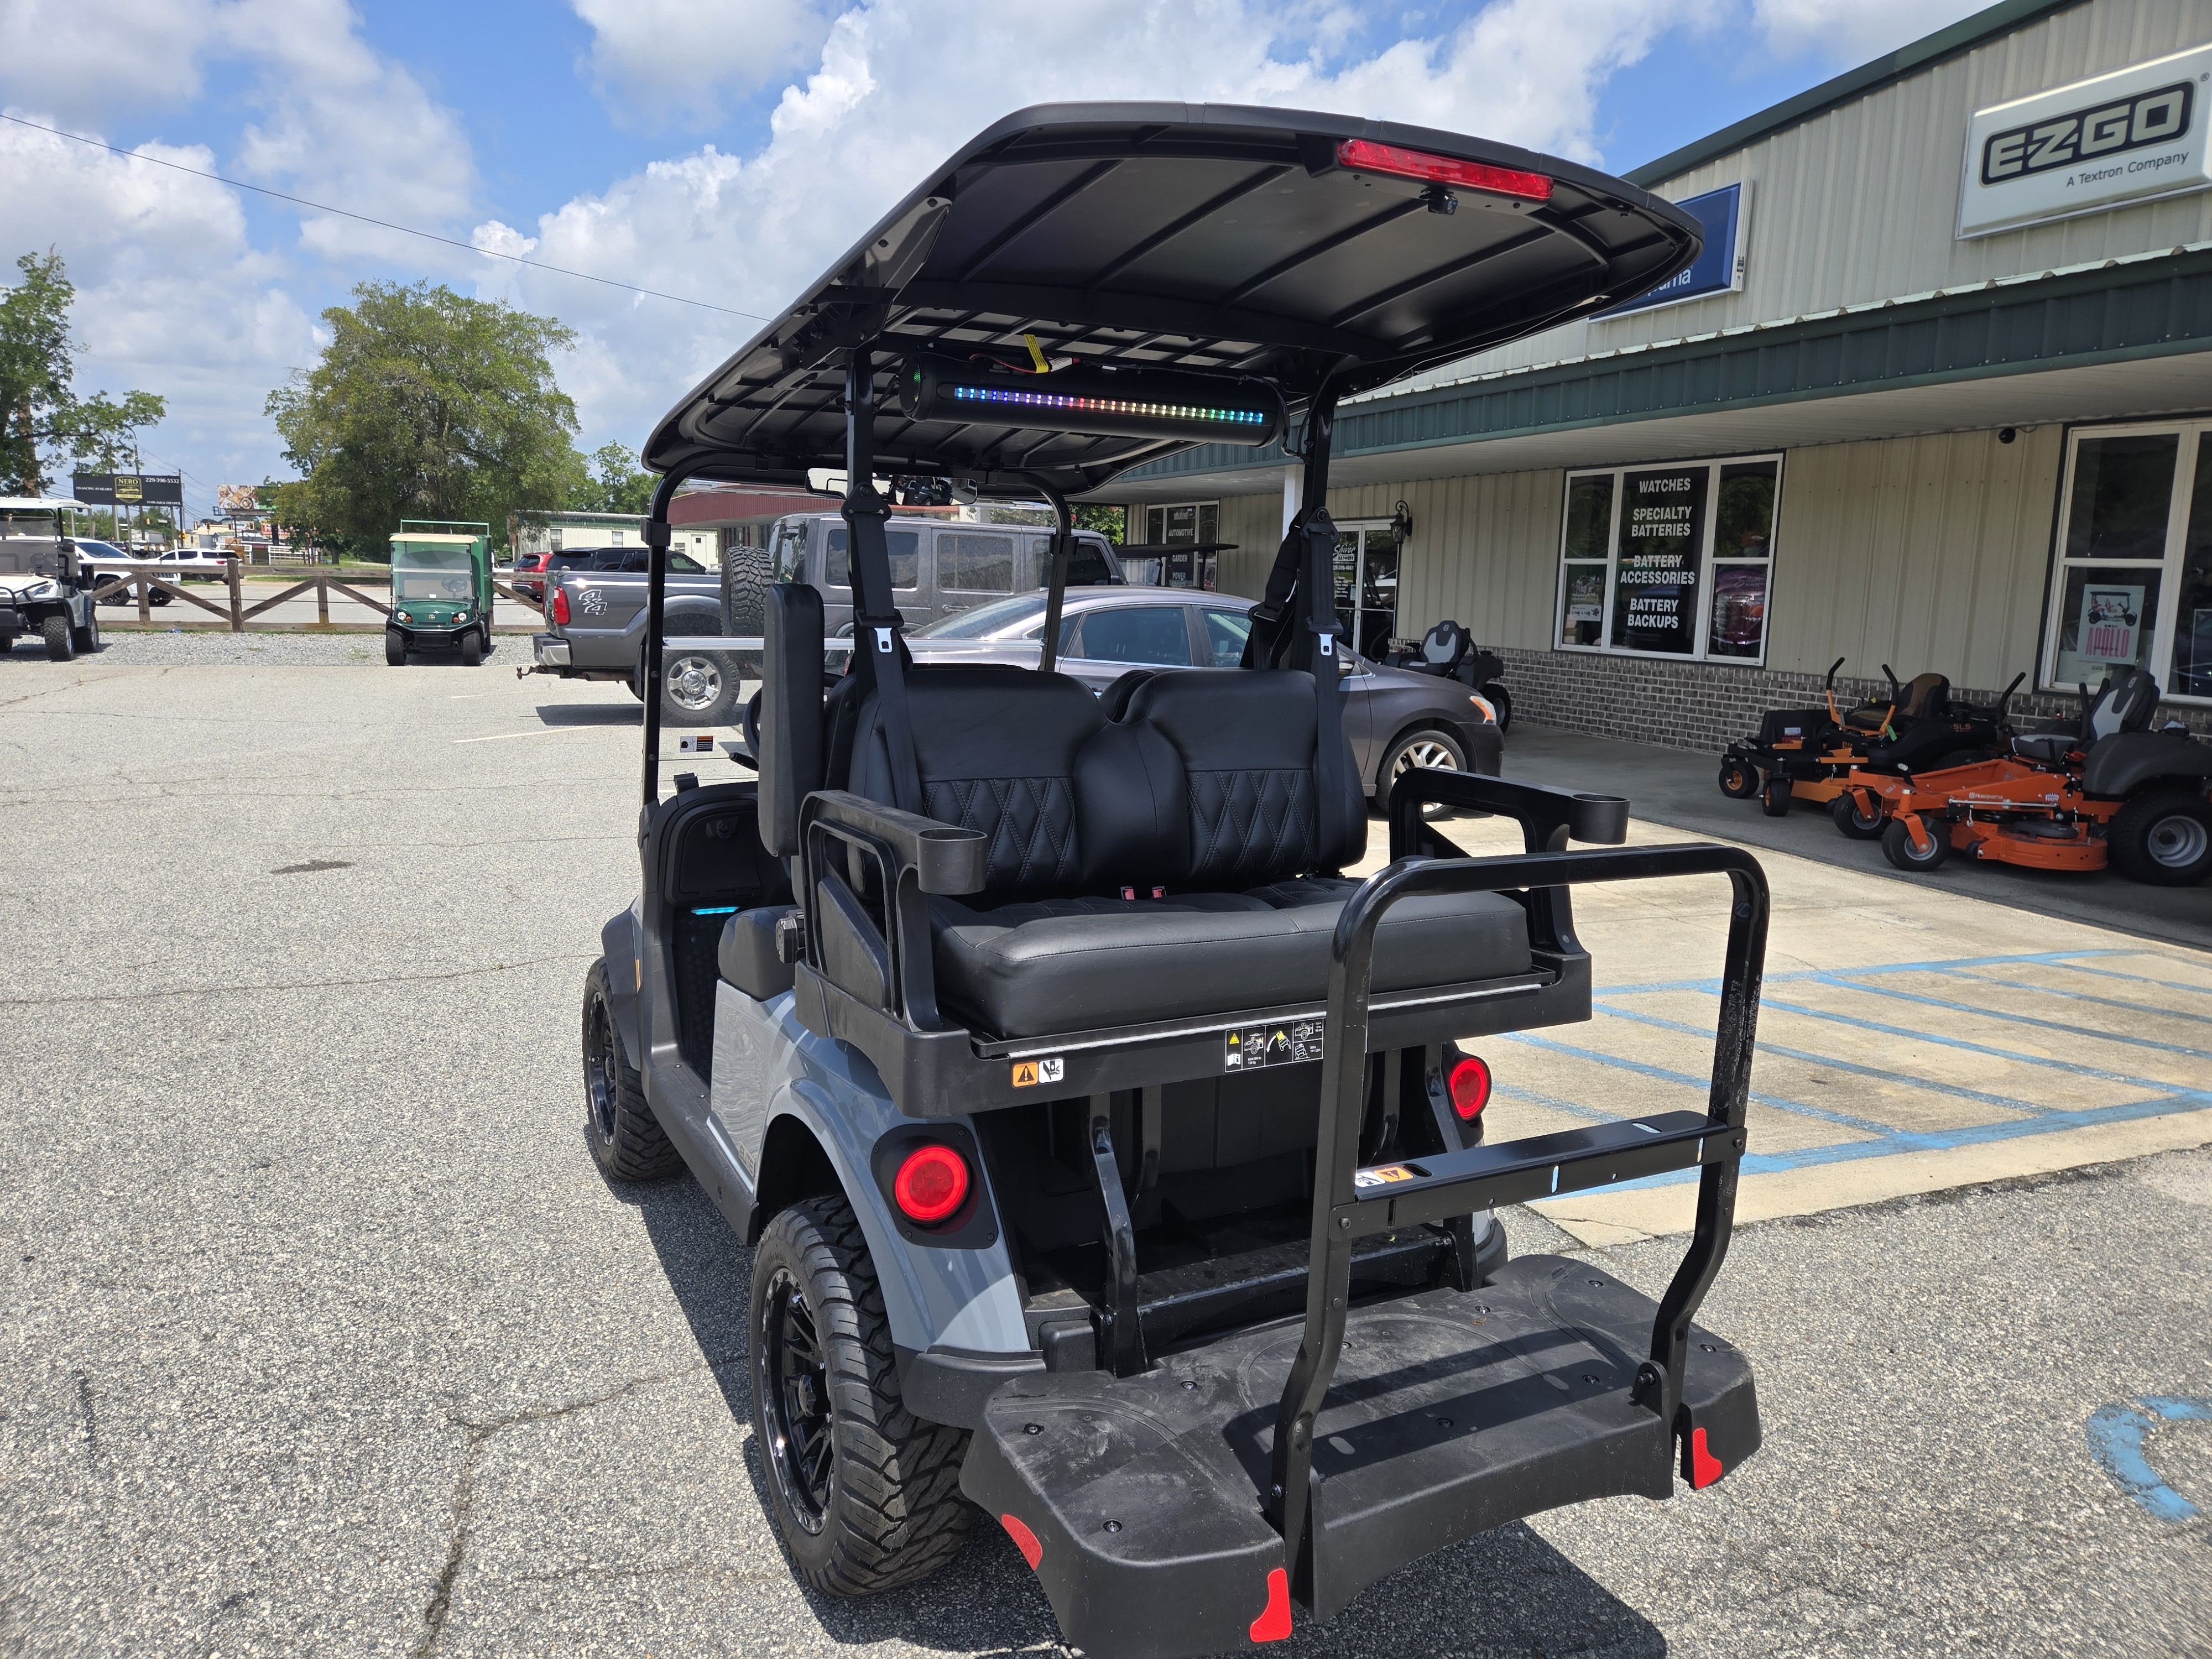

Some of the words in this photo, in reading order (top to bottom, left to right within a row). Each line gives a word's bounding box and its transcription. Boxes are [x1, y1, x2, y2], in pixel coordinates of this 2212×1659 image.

[1987, 90, 2184, 179] EZGO
[2066, 176, 2074, 187] A
[2078, 166, 2124, 185] Textron
[2127, 151, 2189, 174] Company
[1639, 478, 1691, 493] WATCHES
[1174, 512, 1188, 520] MARINE
[1632, 506, 1692, 521] SPECIALTY
[1168, 529, 1193, 537] AUTOMOTIVE
[1631, 523, 1691, 538] BATTERIES
[1333, 544, 1356, 556] Shiver
[1634, 555, 1683, 568] BATTERY
[1620, 571, 1695, 585] ACCESSORIES
[1630, 598, 1678, 612] BATTERY
[1627, 614, 1678, 629] BACKUPS
[2085, 627, 2130, 658] APOLLO
[739, 1144, 754, 1175] ELITE
